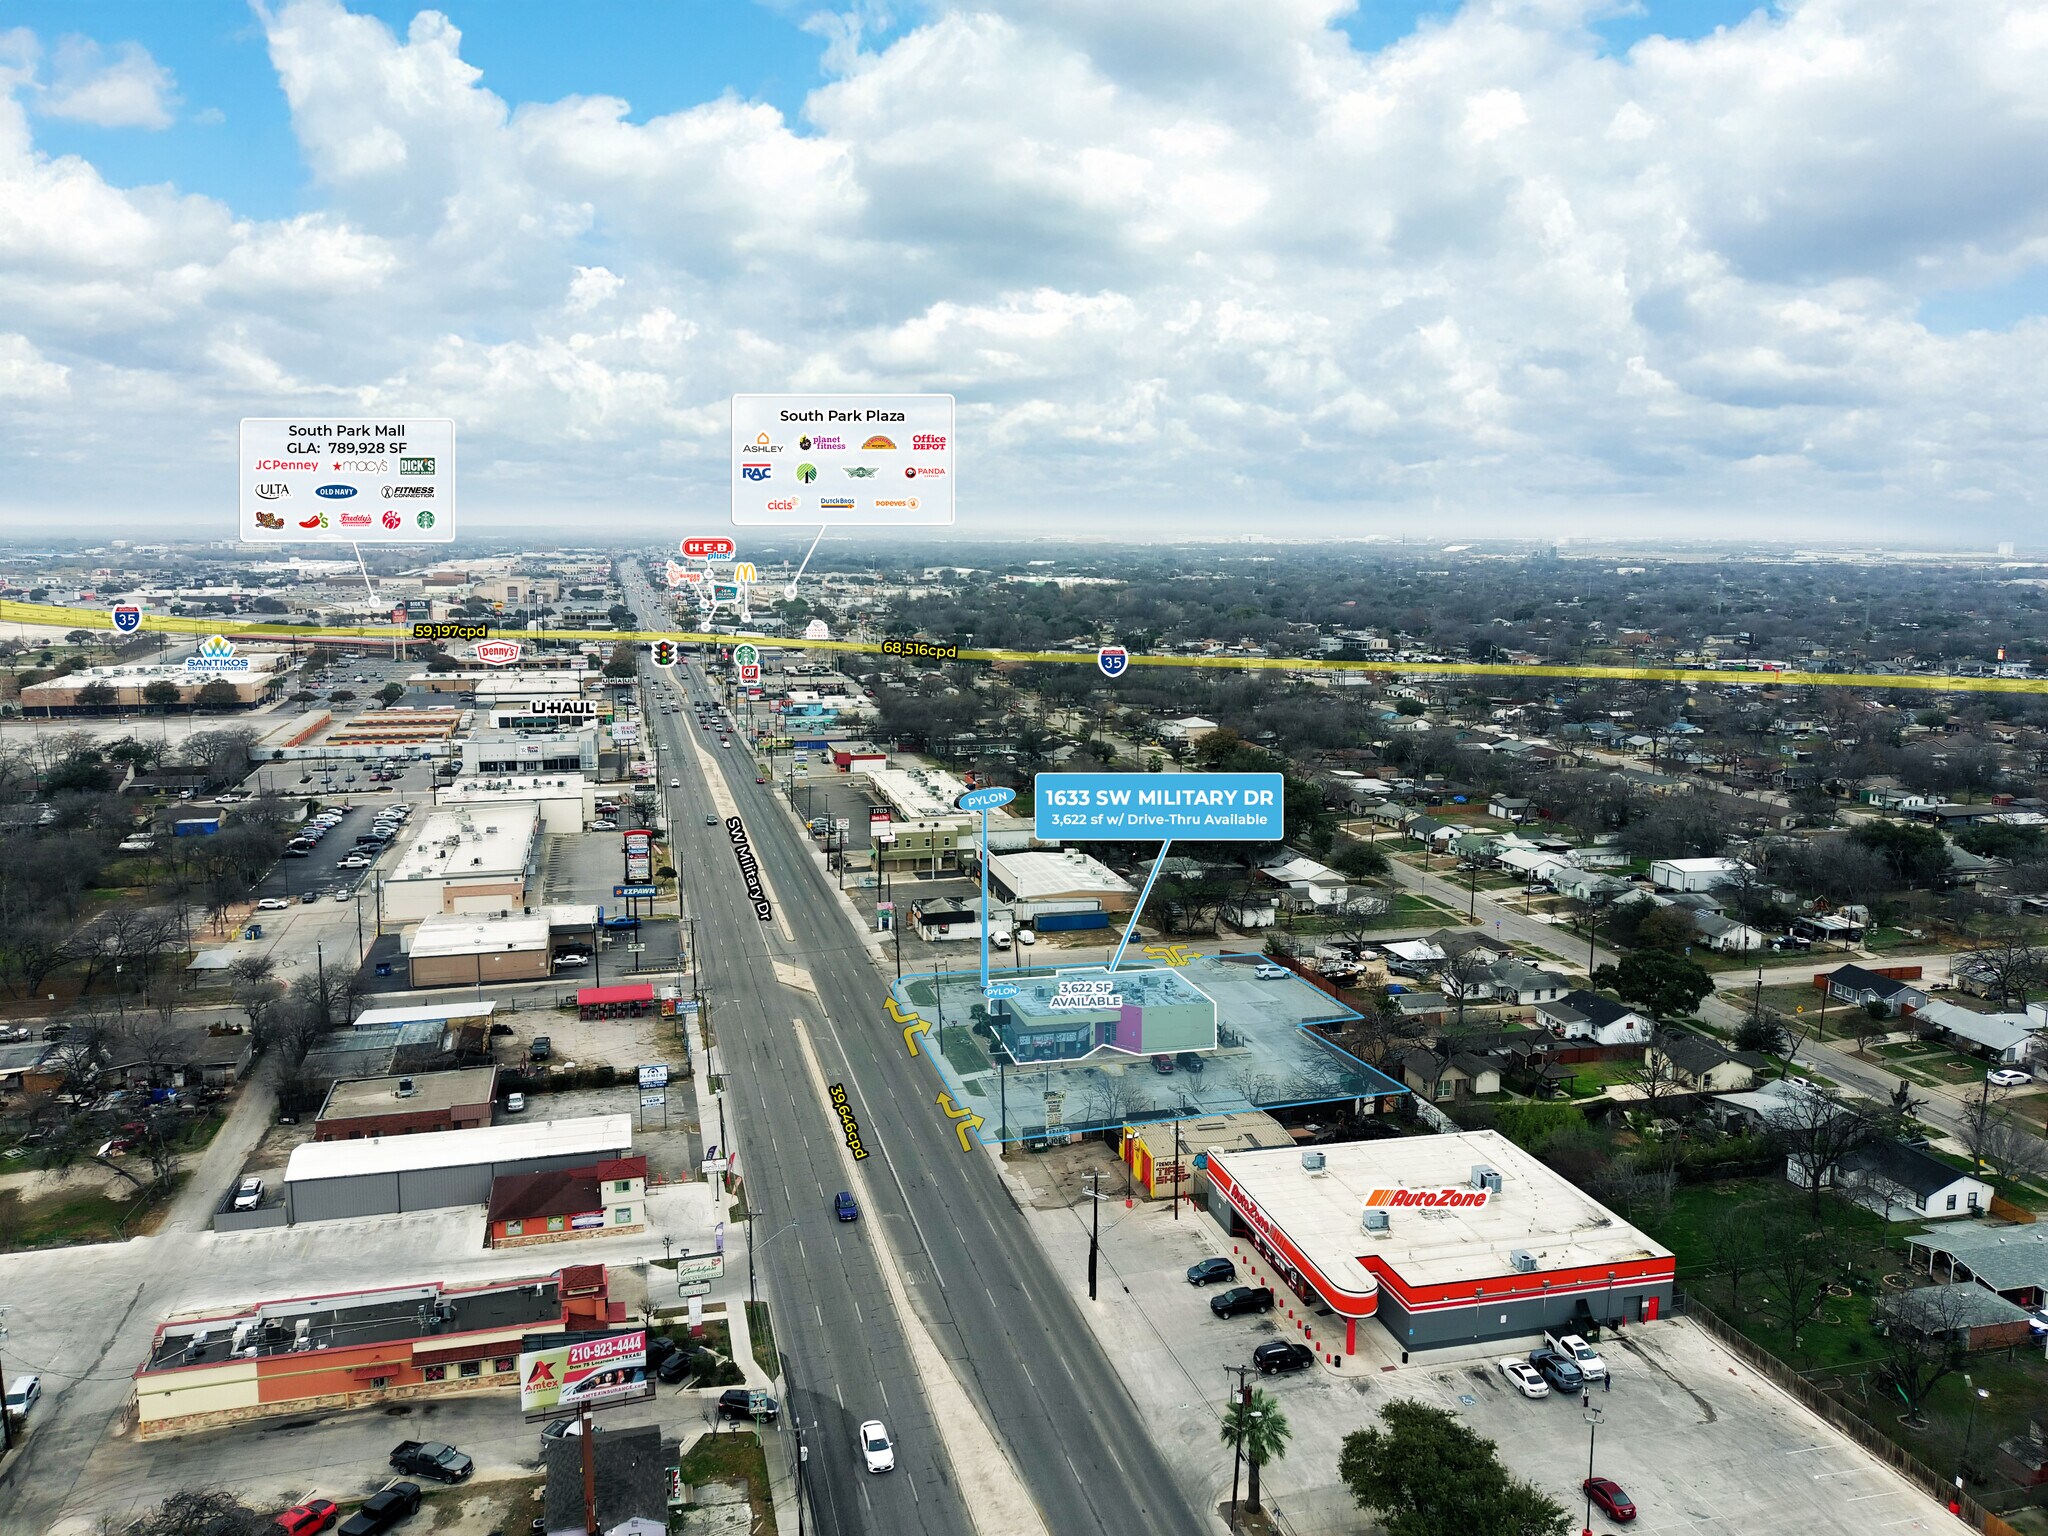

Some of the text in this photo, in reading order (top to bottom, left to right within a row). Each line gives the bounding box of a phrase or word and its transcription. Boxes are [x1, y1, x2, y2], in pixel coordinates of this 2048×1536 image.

[1231, 1184, 1269, 1233] AutoZone
[571, 1336, 641, 1362] 210-923-4444
[525, 1380, 558, 1392] Amtex
